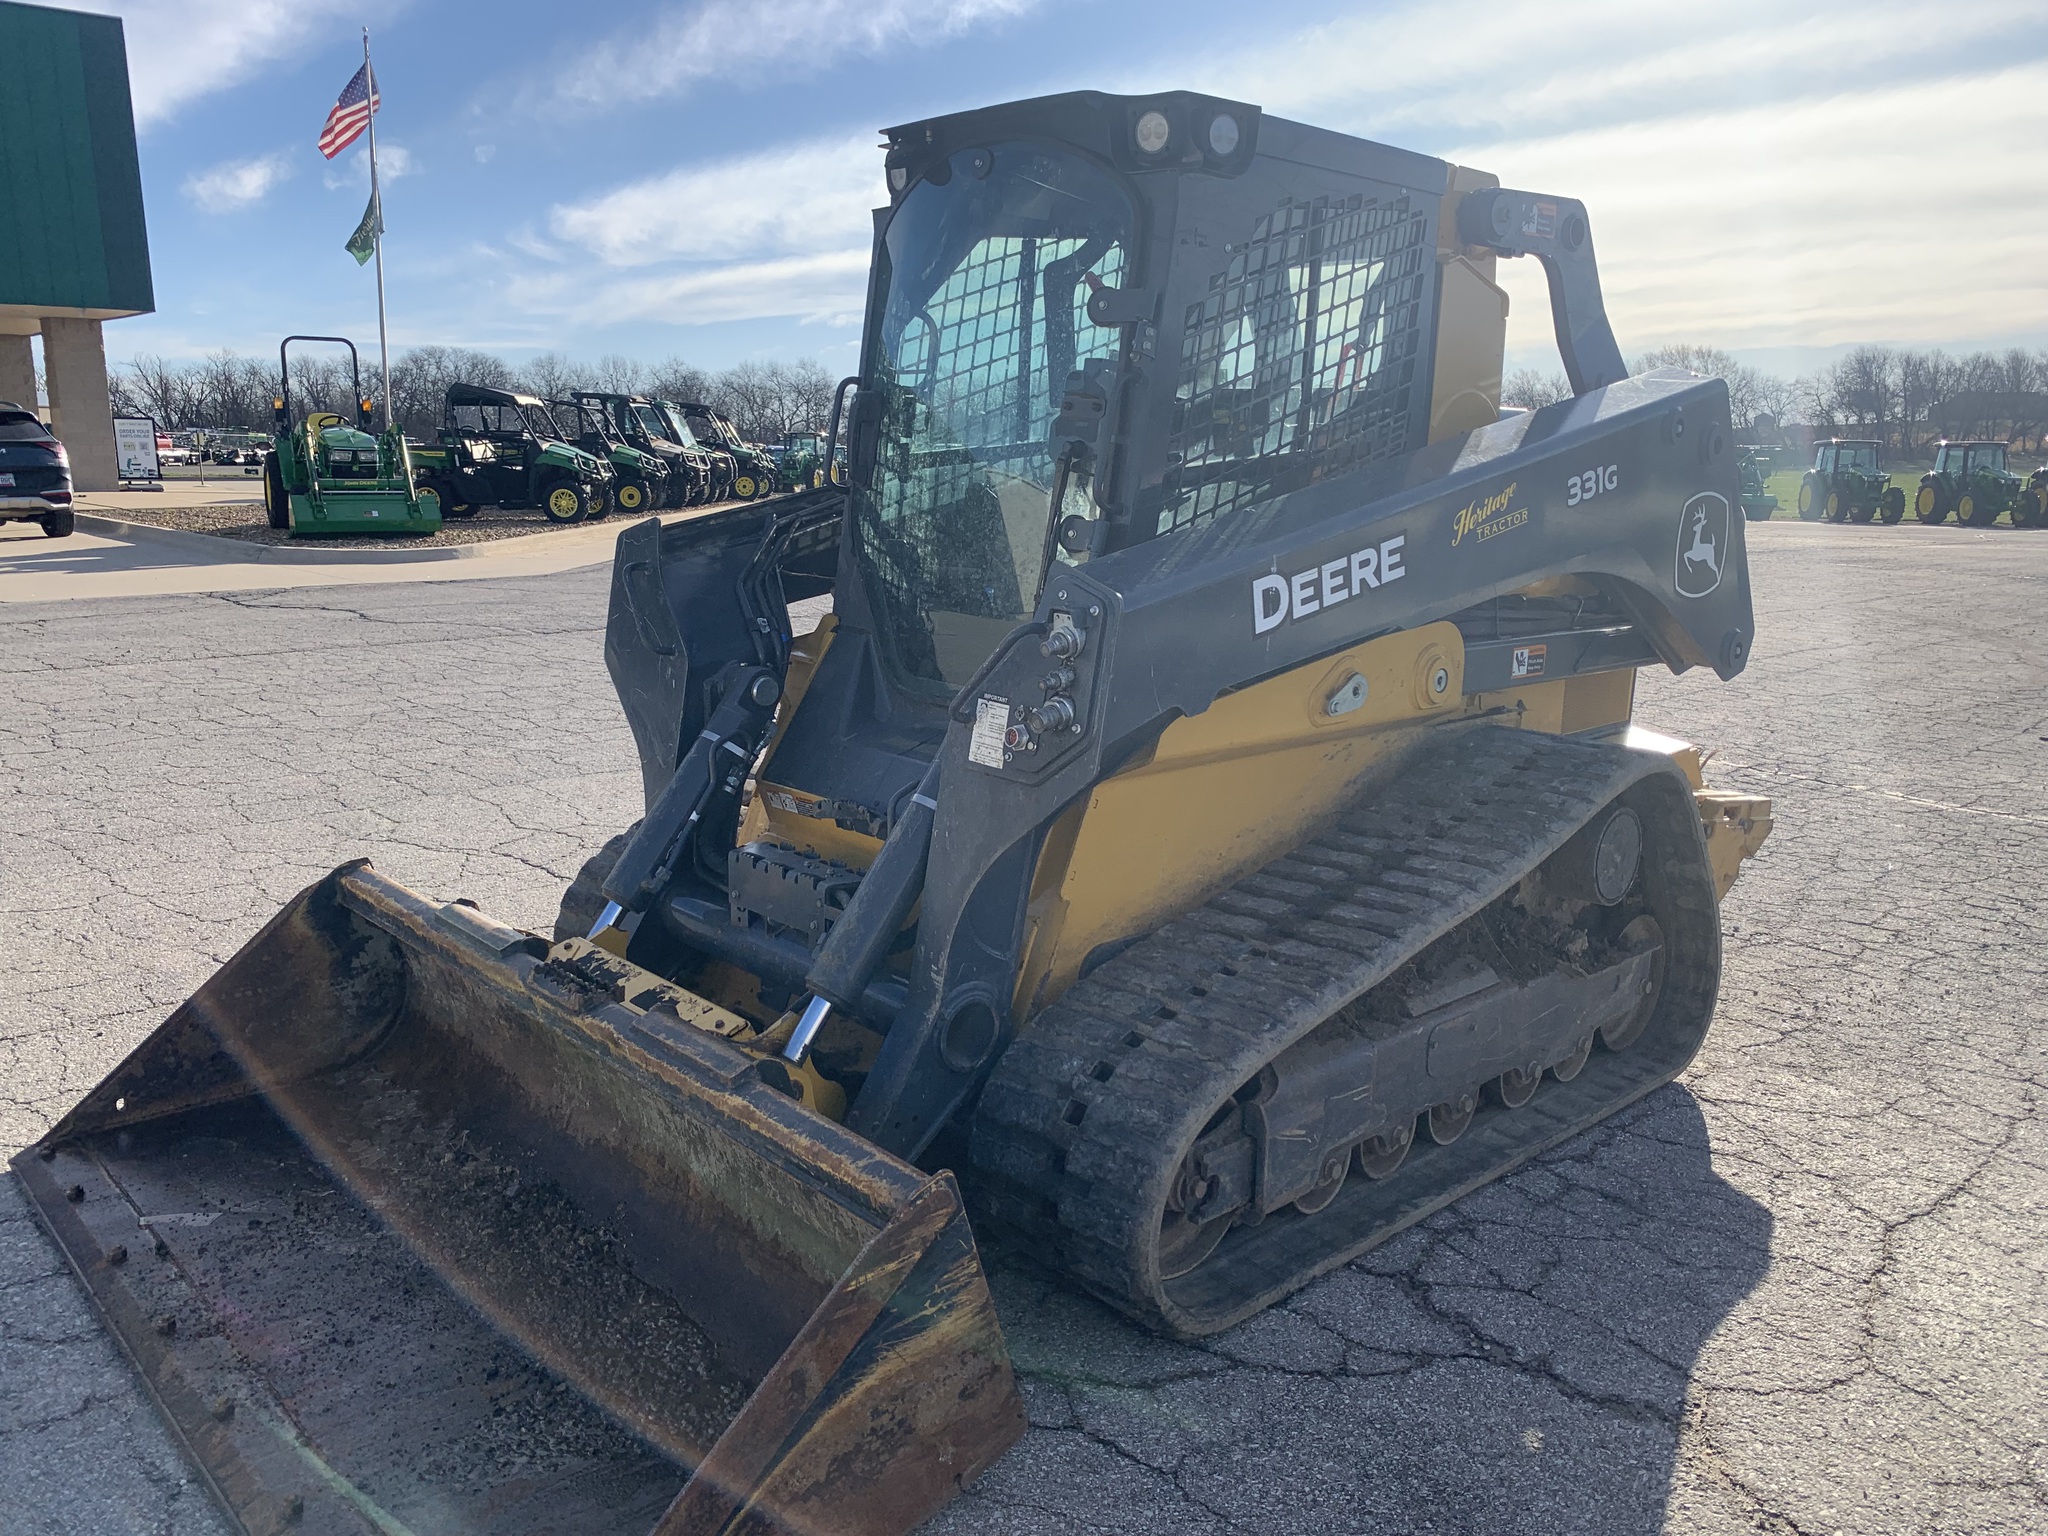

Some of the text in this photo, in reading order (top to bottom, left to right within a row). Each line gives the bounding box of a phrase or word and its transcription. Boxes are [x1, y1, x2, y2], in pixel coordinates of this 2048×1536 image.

[1567, 464, 1618, 506] 331G
[1451, 481, 1517, 547] Heritage
[1476, 510, 1528, 540] TRACTOR
[1253, 535, 1405, 634] DEERE
[983, 692, 1008, 704] IMPORTANT
